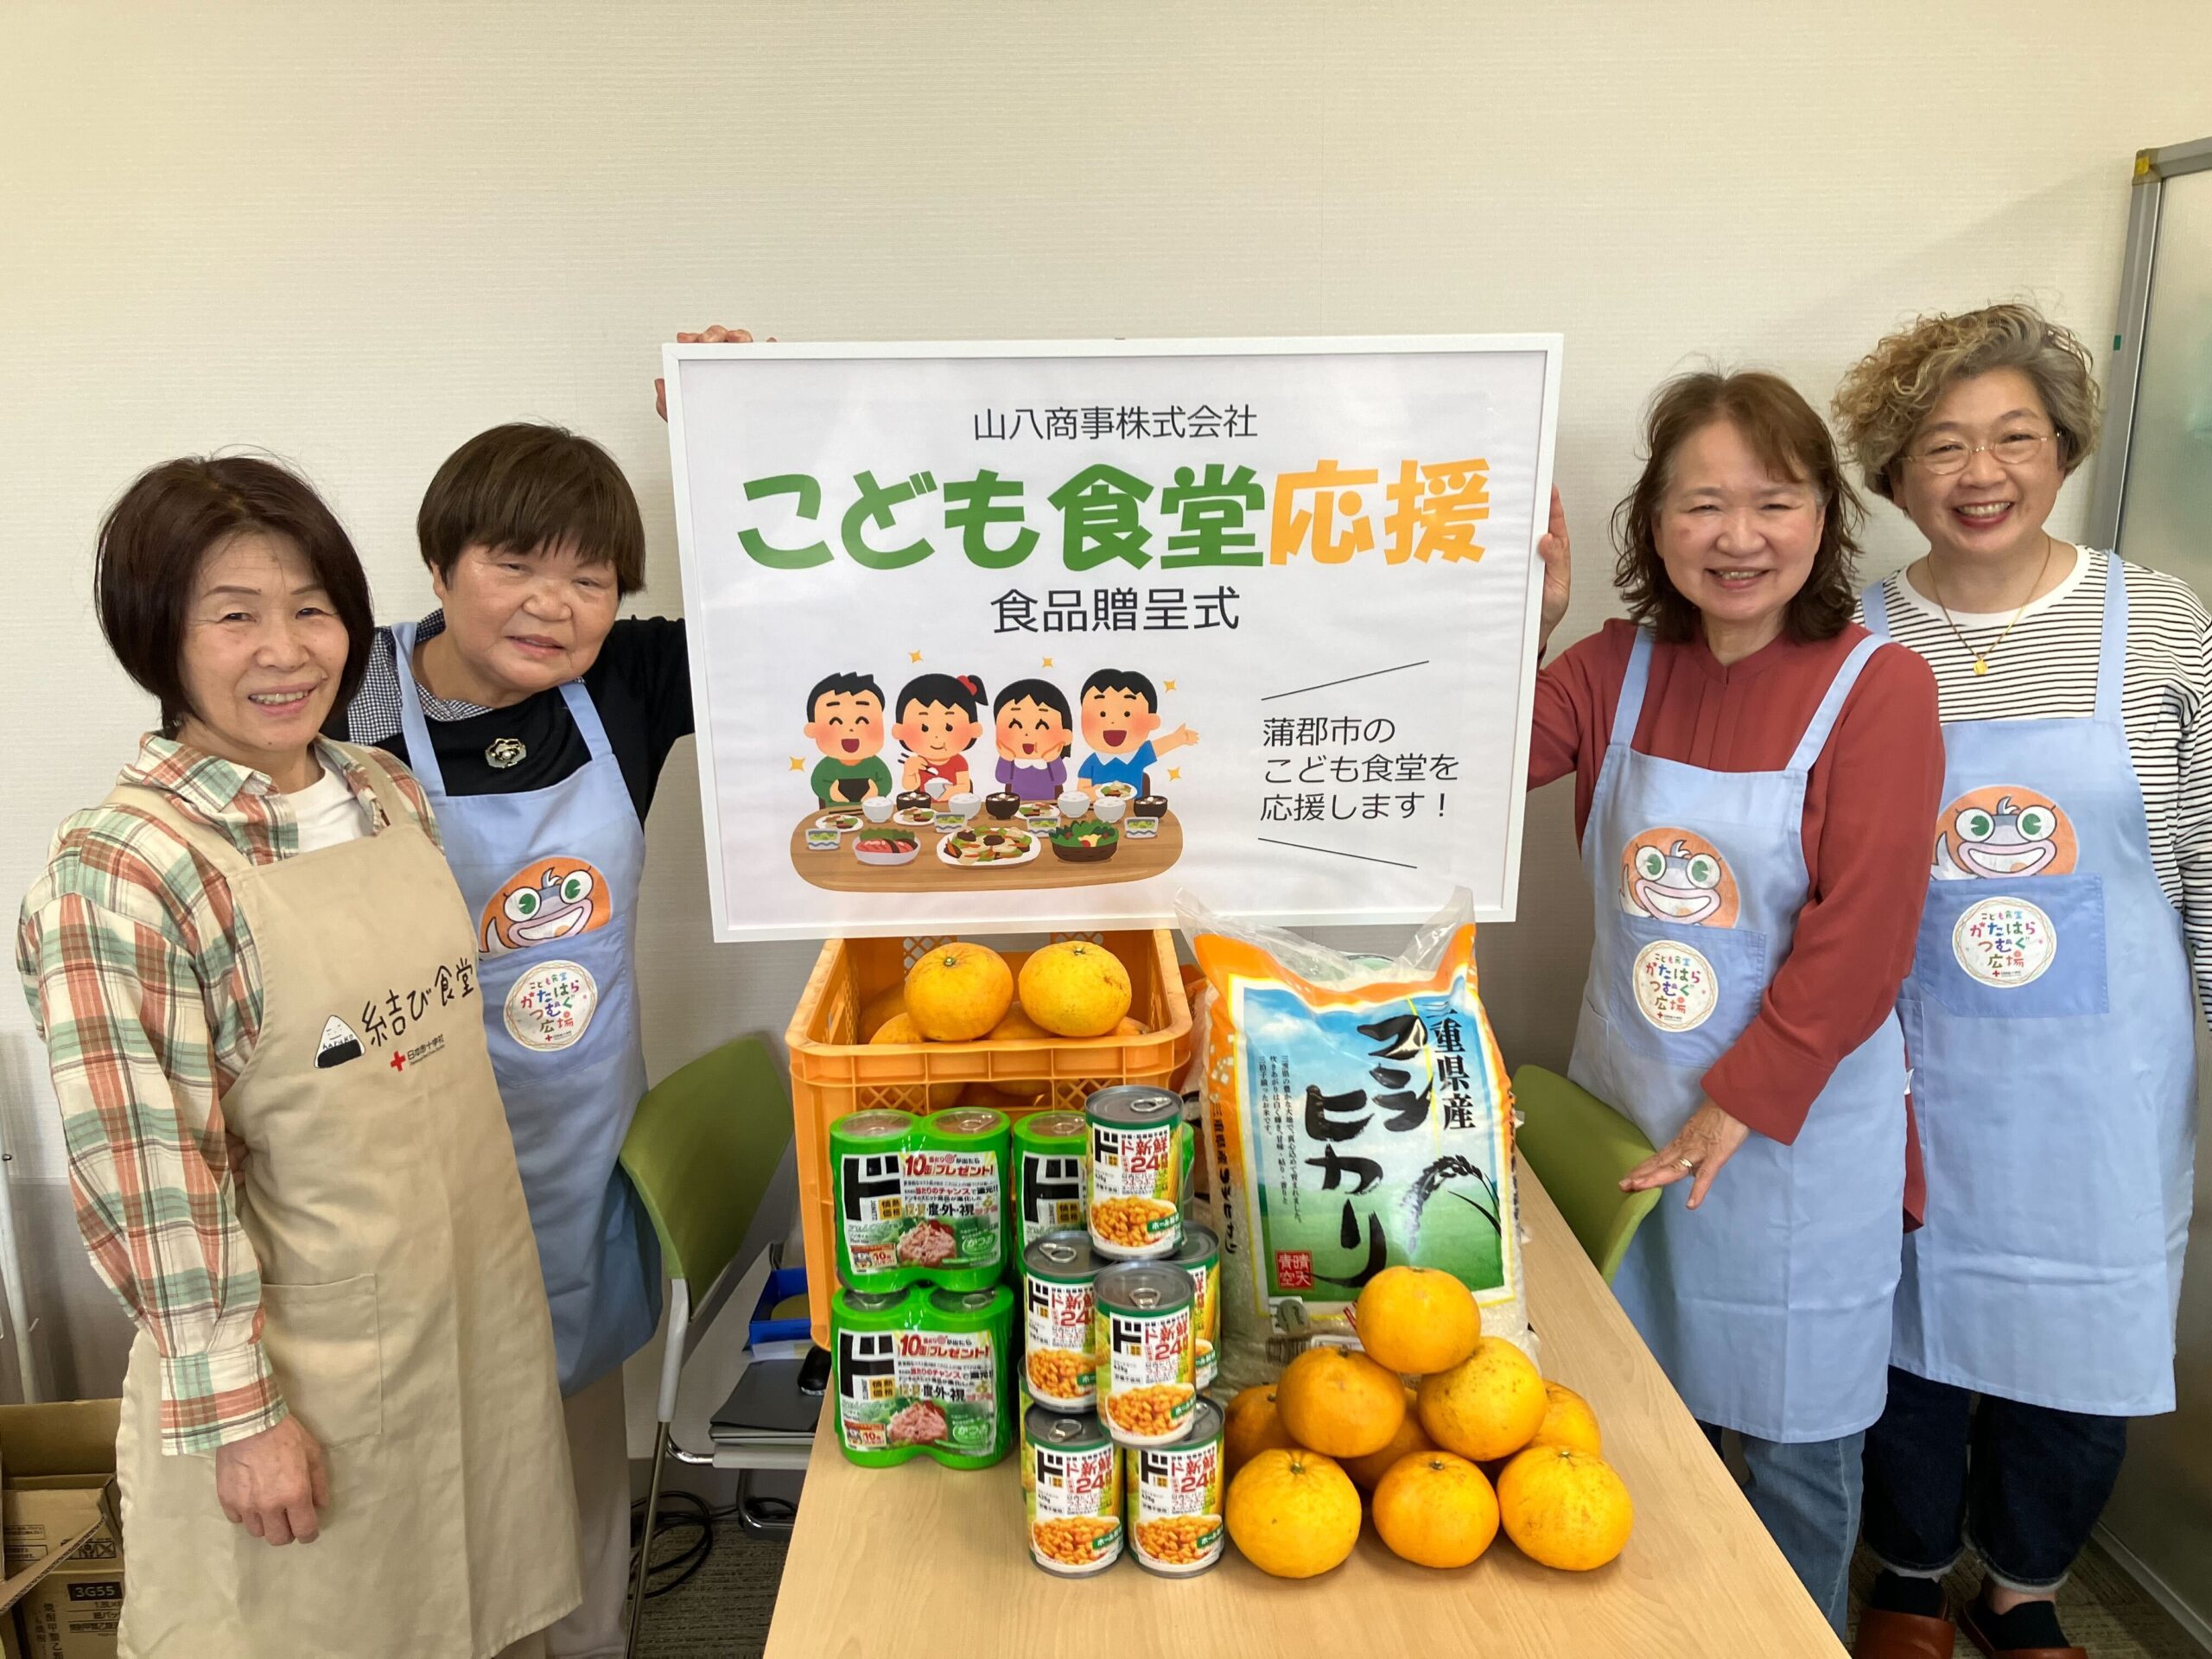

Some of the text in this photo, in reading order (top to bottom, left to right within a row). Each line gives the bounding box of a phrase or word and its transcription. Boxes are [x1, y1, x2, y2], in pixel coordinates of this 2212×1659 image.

[973, 404, 1258, 442] 山八商事株式会社
[736, 457, 1492, 572] こども食堂応援
[990, 587, 1241, 635] 食品贈呈式
[1262, 715, 1395, 748] 蒲郡市の
[1264, 752, 1459, 785] こども食堂を
[1260, 790, 1449, 822] 応援します！
[361, 957, 474, 1047] 結び食堂
[76, 1586, 115, 1598] 3G55
